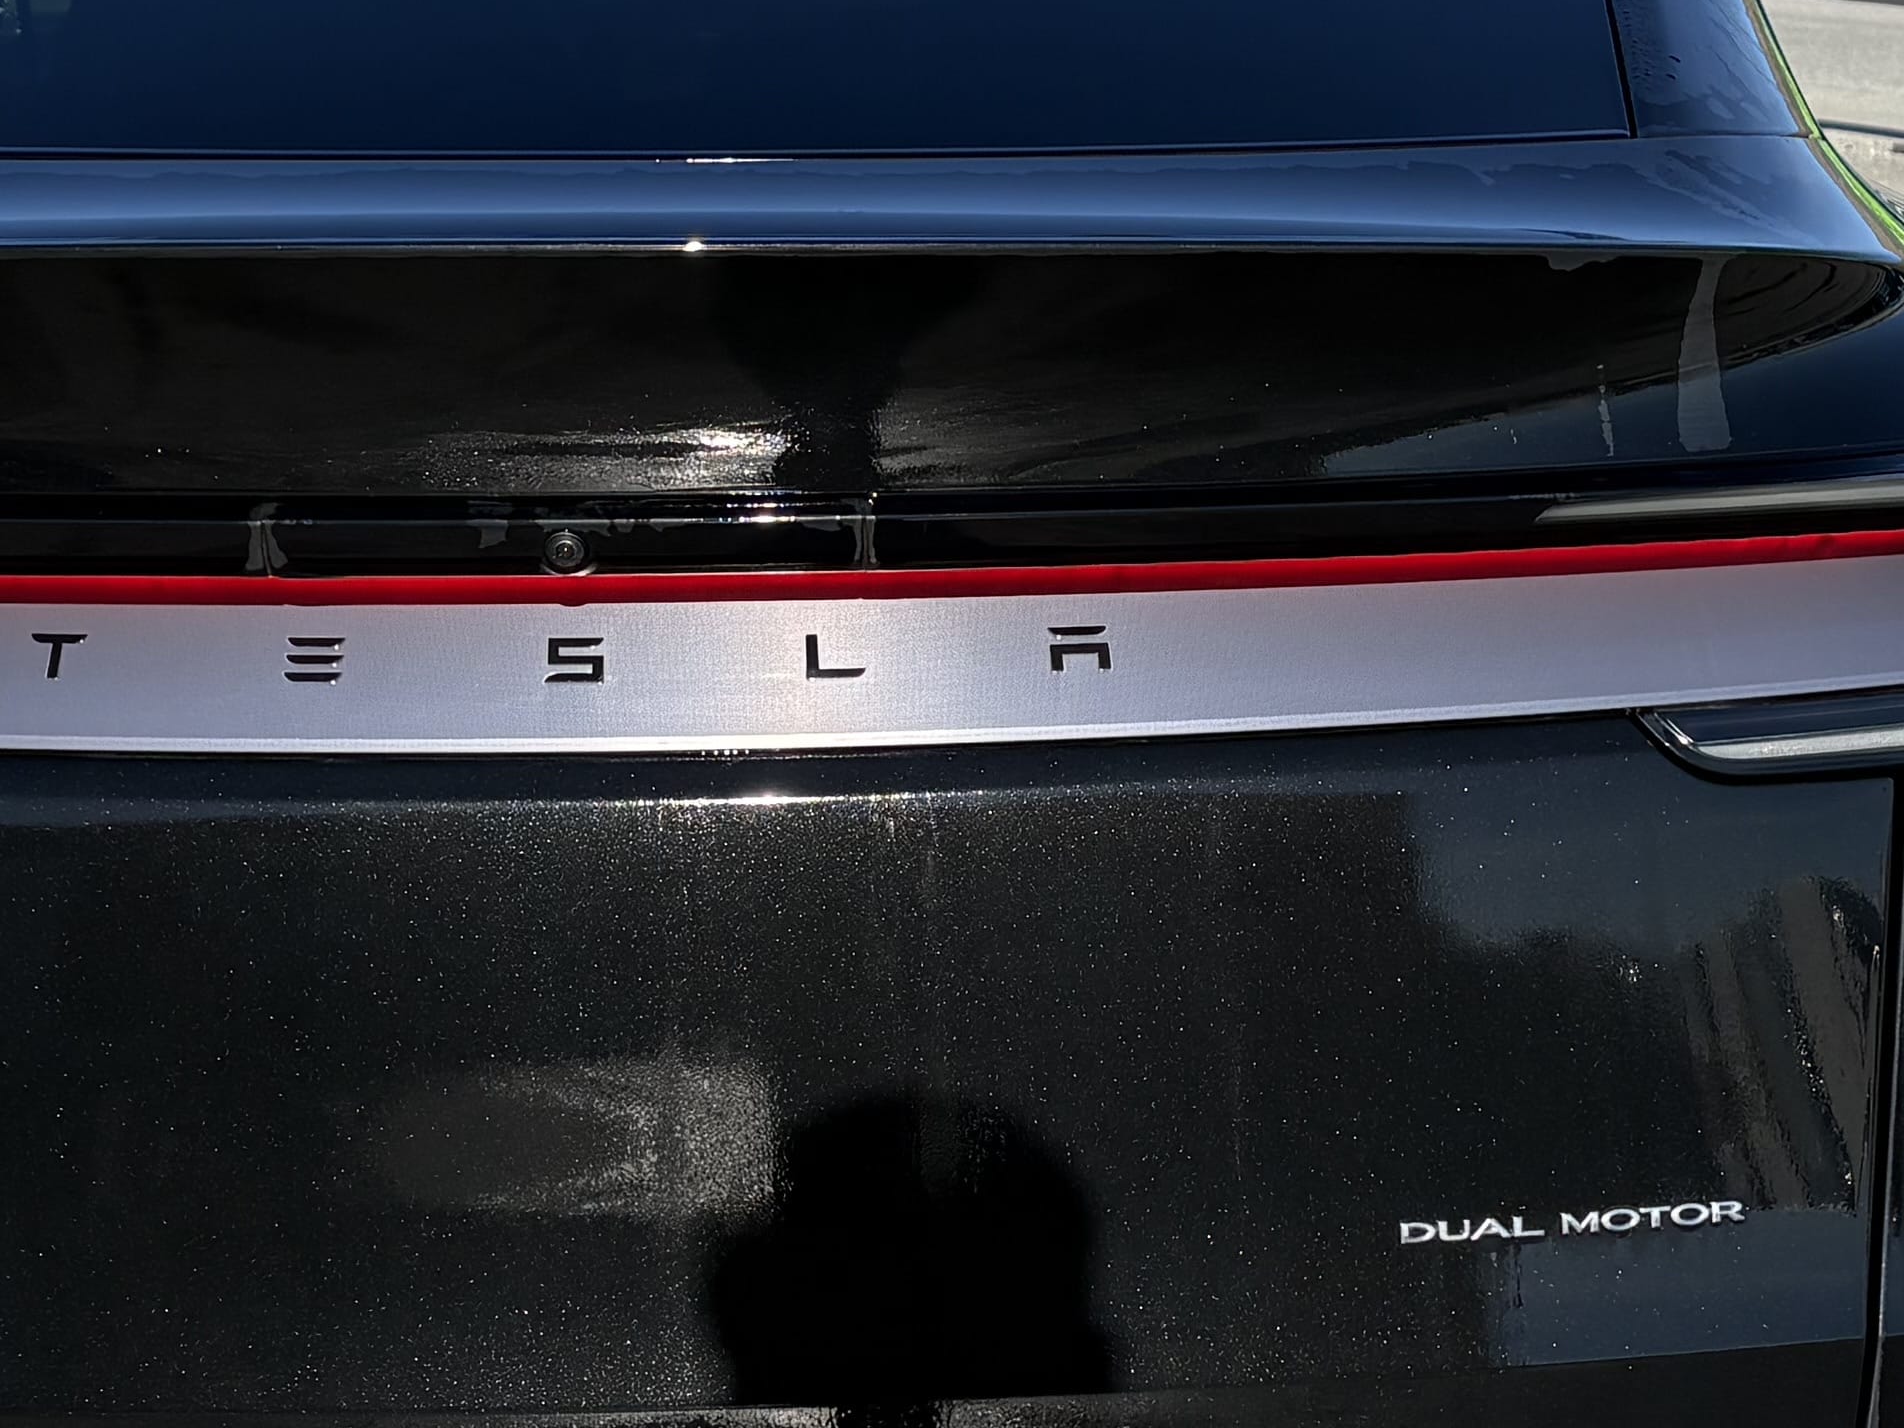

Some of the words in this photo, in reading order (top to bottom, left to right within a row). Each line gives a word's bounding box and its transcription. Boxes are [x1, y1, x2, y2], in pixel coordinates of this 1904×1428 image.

[31, 624, 1113, 683] TESLA
[1399, 1215, 1546, 1245] DUAL
[1559, 1199, 1747, 1238] MOTOR
